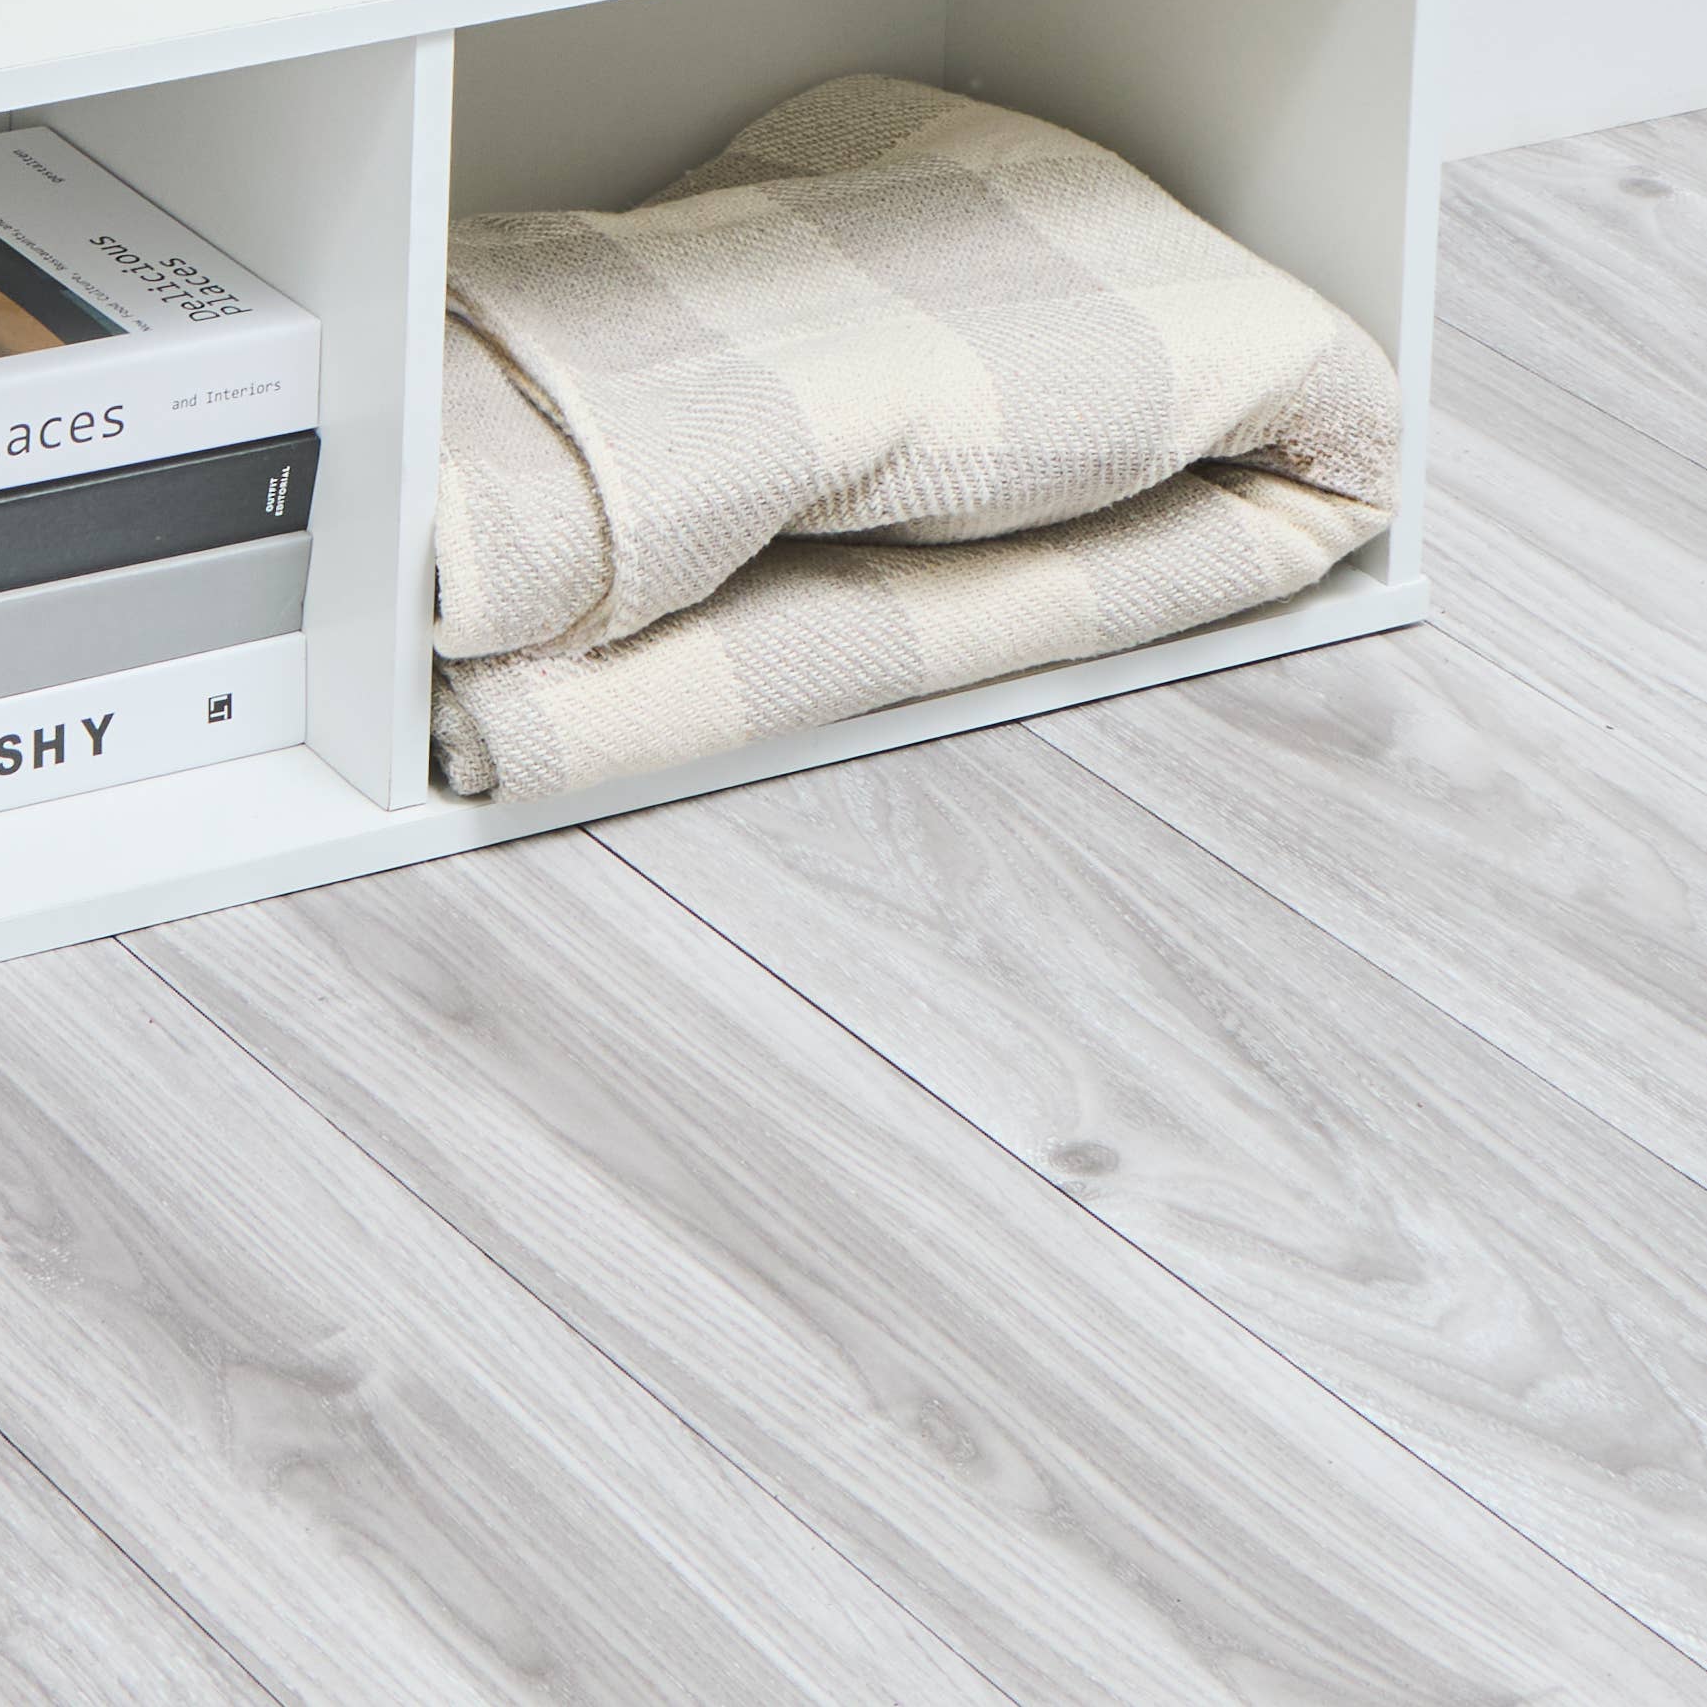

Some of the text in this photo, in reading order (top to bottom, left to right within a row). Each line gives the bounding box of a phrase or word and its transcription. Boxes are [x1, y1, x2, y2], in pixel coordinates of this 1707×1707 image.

[13, 149, 66, 183] gestalten
[89, 235, 220, 322] Delicious
[159, 257, 253, 317] Places
[108, 302, 134, 318] Food
[172, 379, 282, 411] and Interiors
[265, 477, 278, 513] OUTFIT
[275, 465, 291, 516] EDITORIAL
